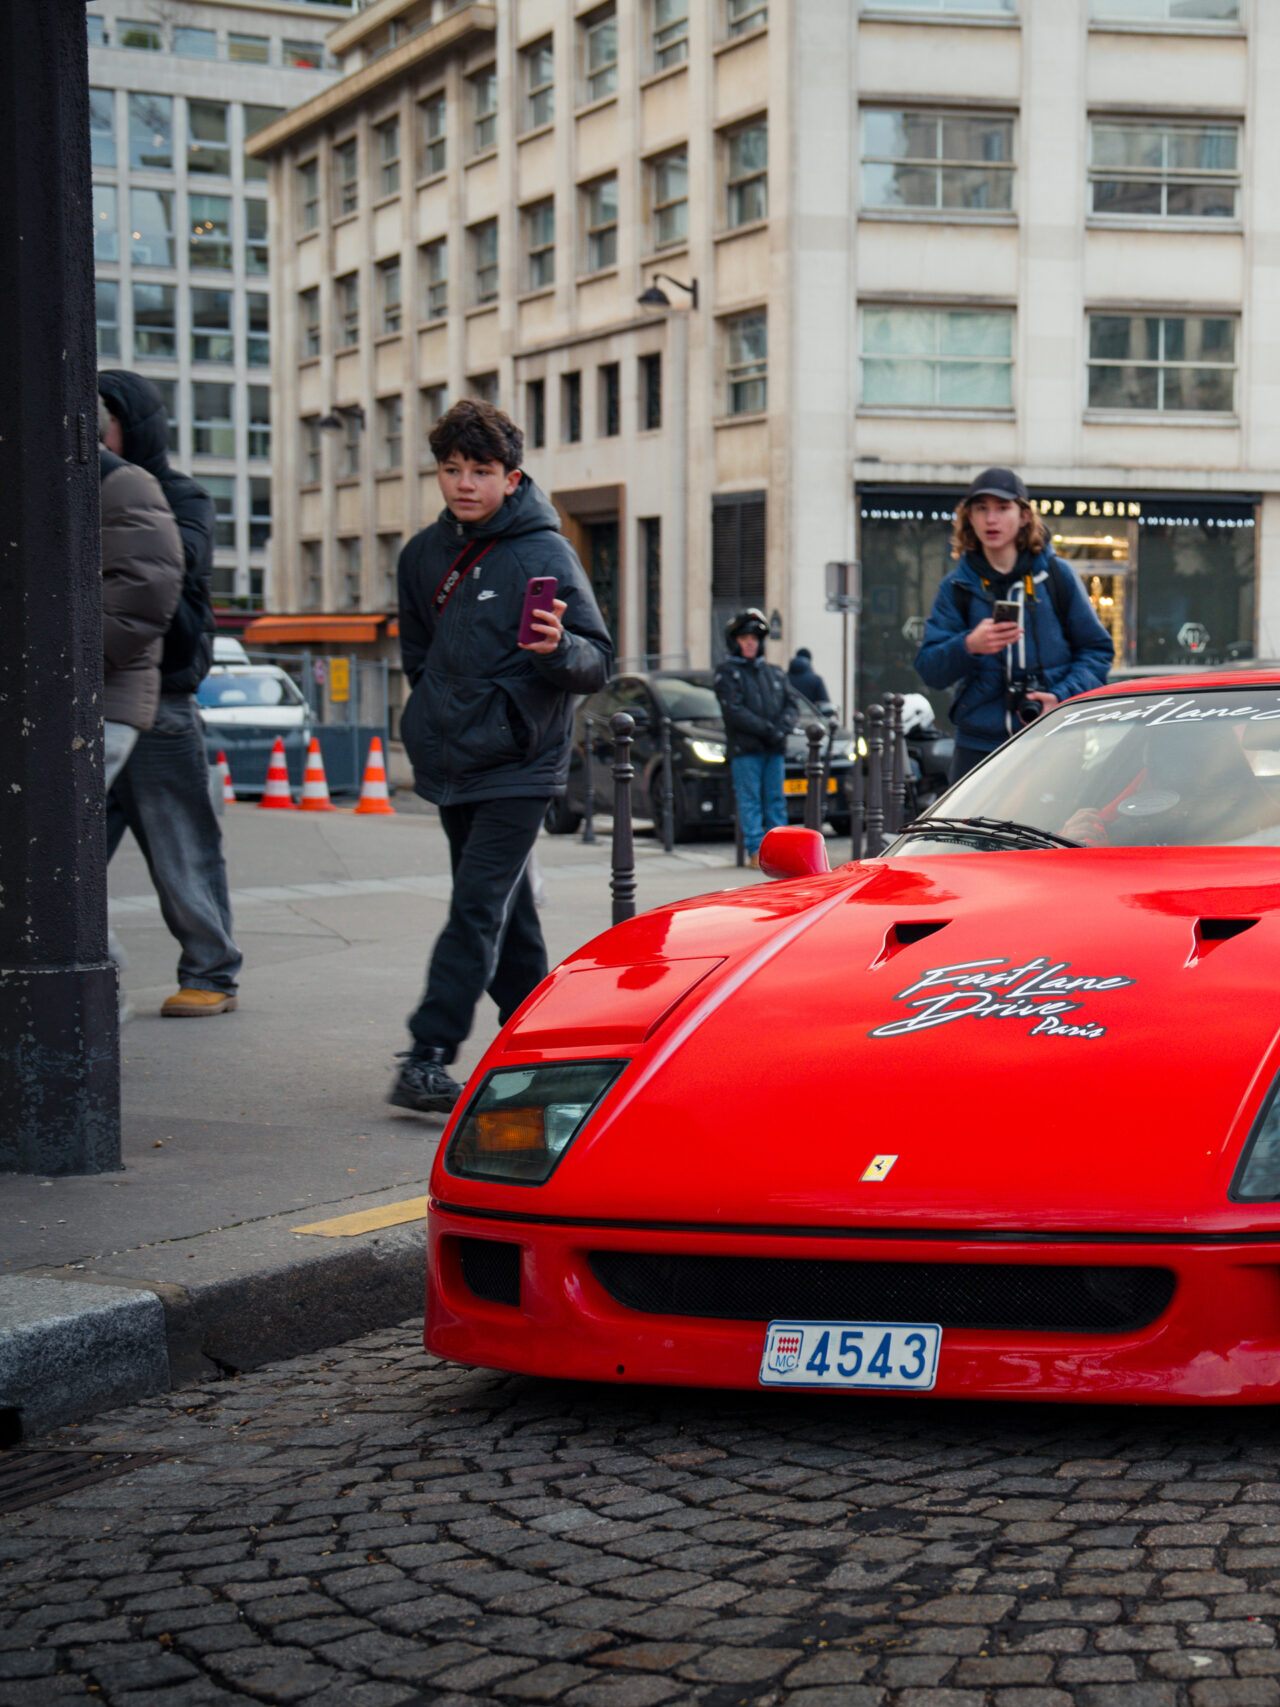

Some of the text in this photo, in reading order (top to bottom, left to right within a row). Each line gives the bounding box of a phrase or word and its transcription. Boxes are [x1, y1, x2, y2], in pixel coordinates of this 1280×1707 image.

[1076, 500, 1141, 517] PLEIN
[1045, 697, 1173, 737] Fast
[1146, 700, 1264, 727] Lane
[895, 957, 1136, 1000] Fast Lane
[868, 989, 1083, 1038] Drive
[1028, 1014, 1107, 1039] Paris
[775, 1330, 928, 1380] MC 4543
